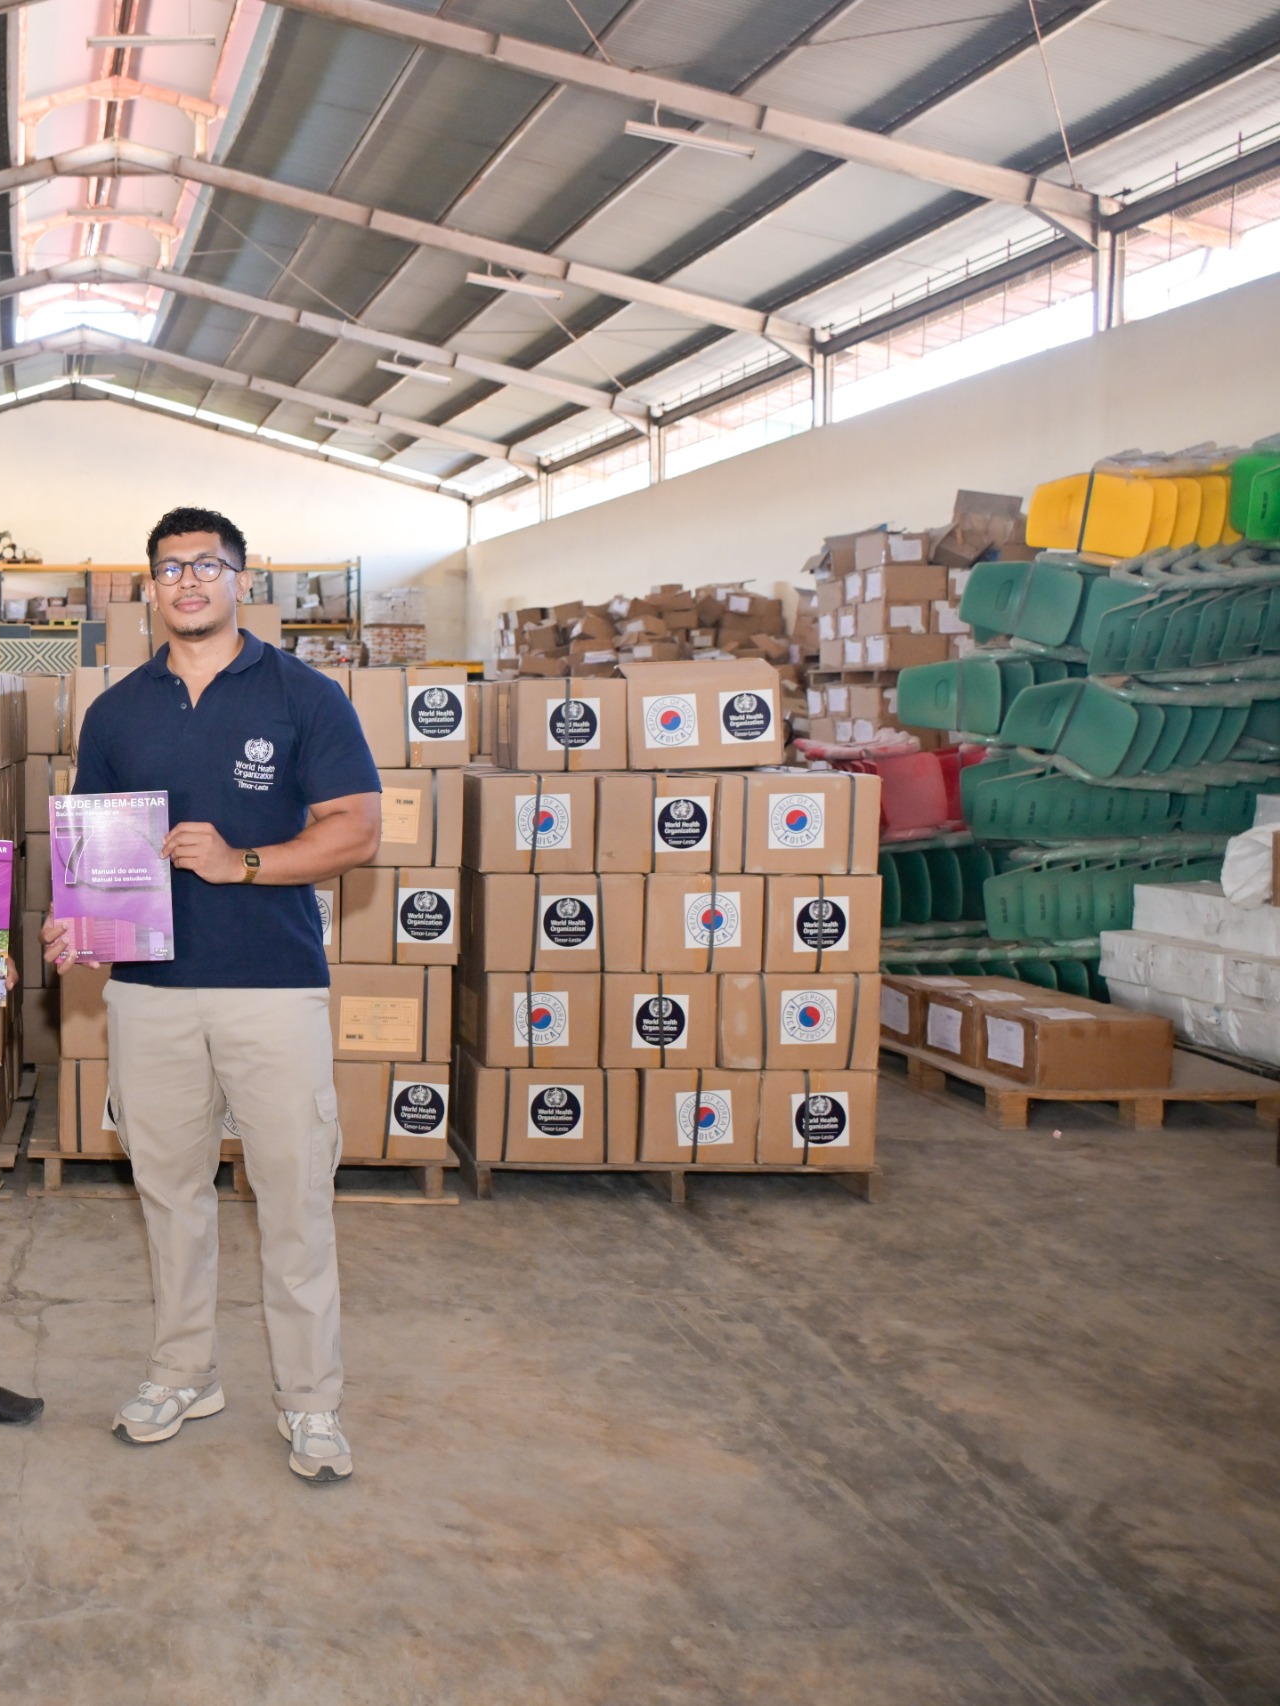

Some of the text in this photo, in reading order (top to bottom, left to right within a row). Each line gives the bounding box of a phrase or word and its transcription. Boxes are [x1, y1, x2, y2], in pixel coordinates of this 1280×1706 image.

[418, 716, 454, 724] Organization
[729, 719, 764, 727] Organization
[660, 732, 686, 743] KOICA
[236, 760, 255, 771] World
[234, 768, 273, 779] Organization
[55, 797, 165, 809] SAÚDE E BEM-ESTAR
[531, 834, 558, 845] OICA
[783, 833, 811, 844] KOICA
[55, 826, 97, 884] 7
[786, 1005, 796, 1032] KOICA
[528, 1031, 556, 1042] OICA
[401, 1112, 436, 1120] Organization
[692, 1129, 720, 1140] OICA
